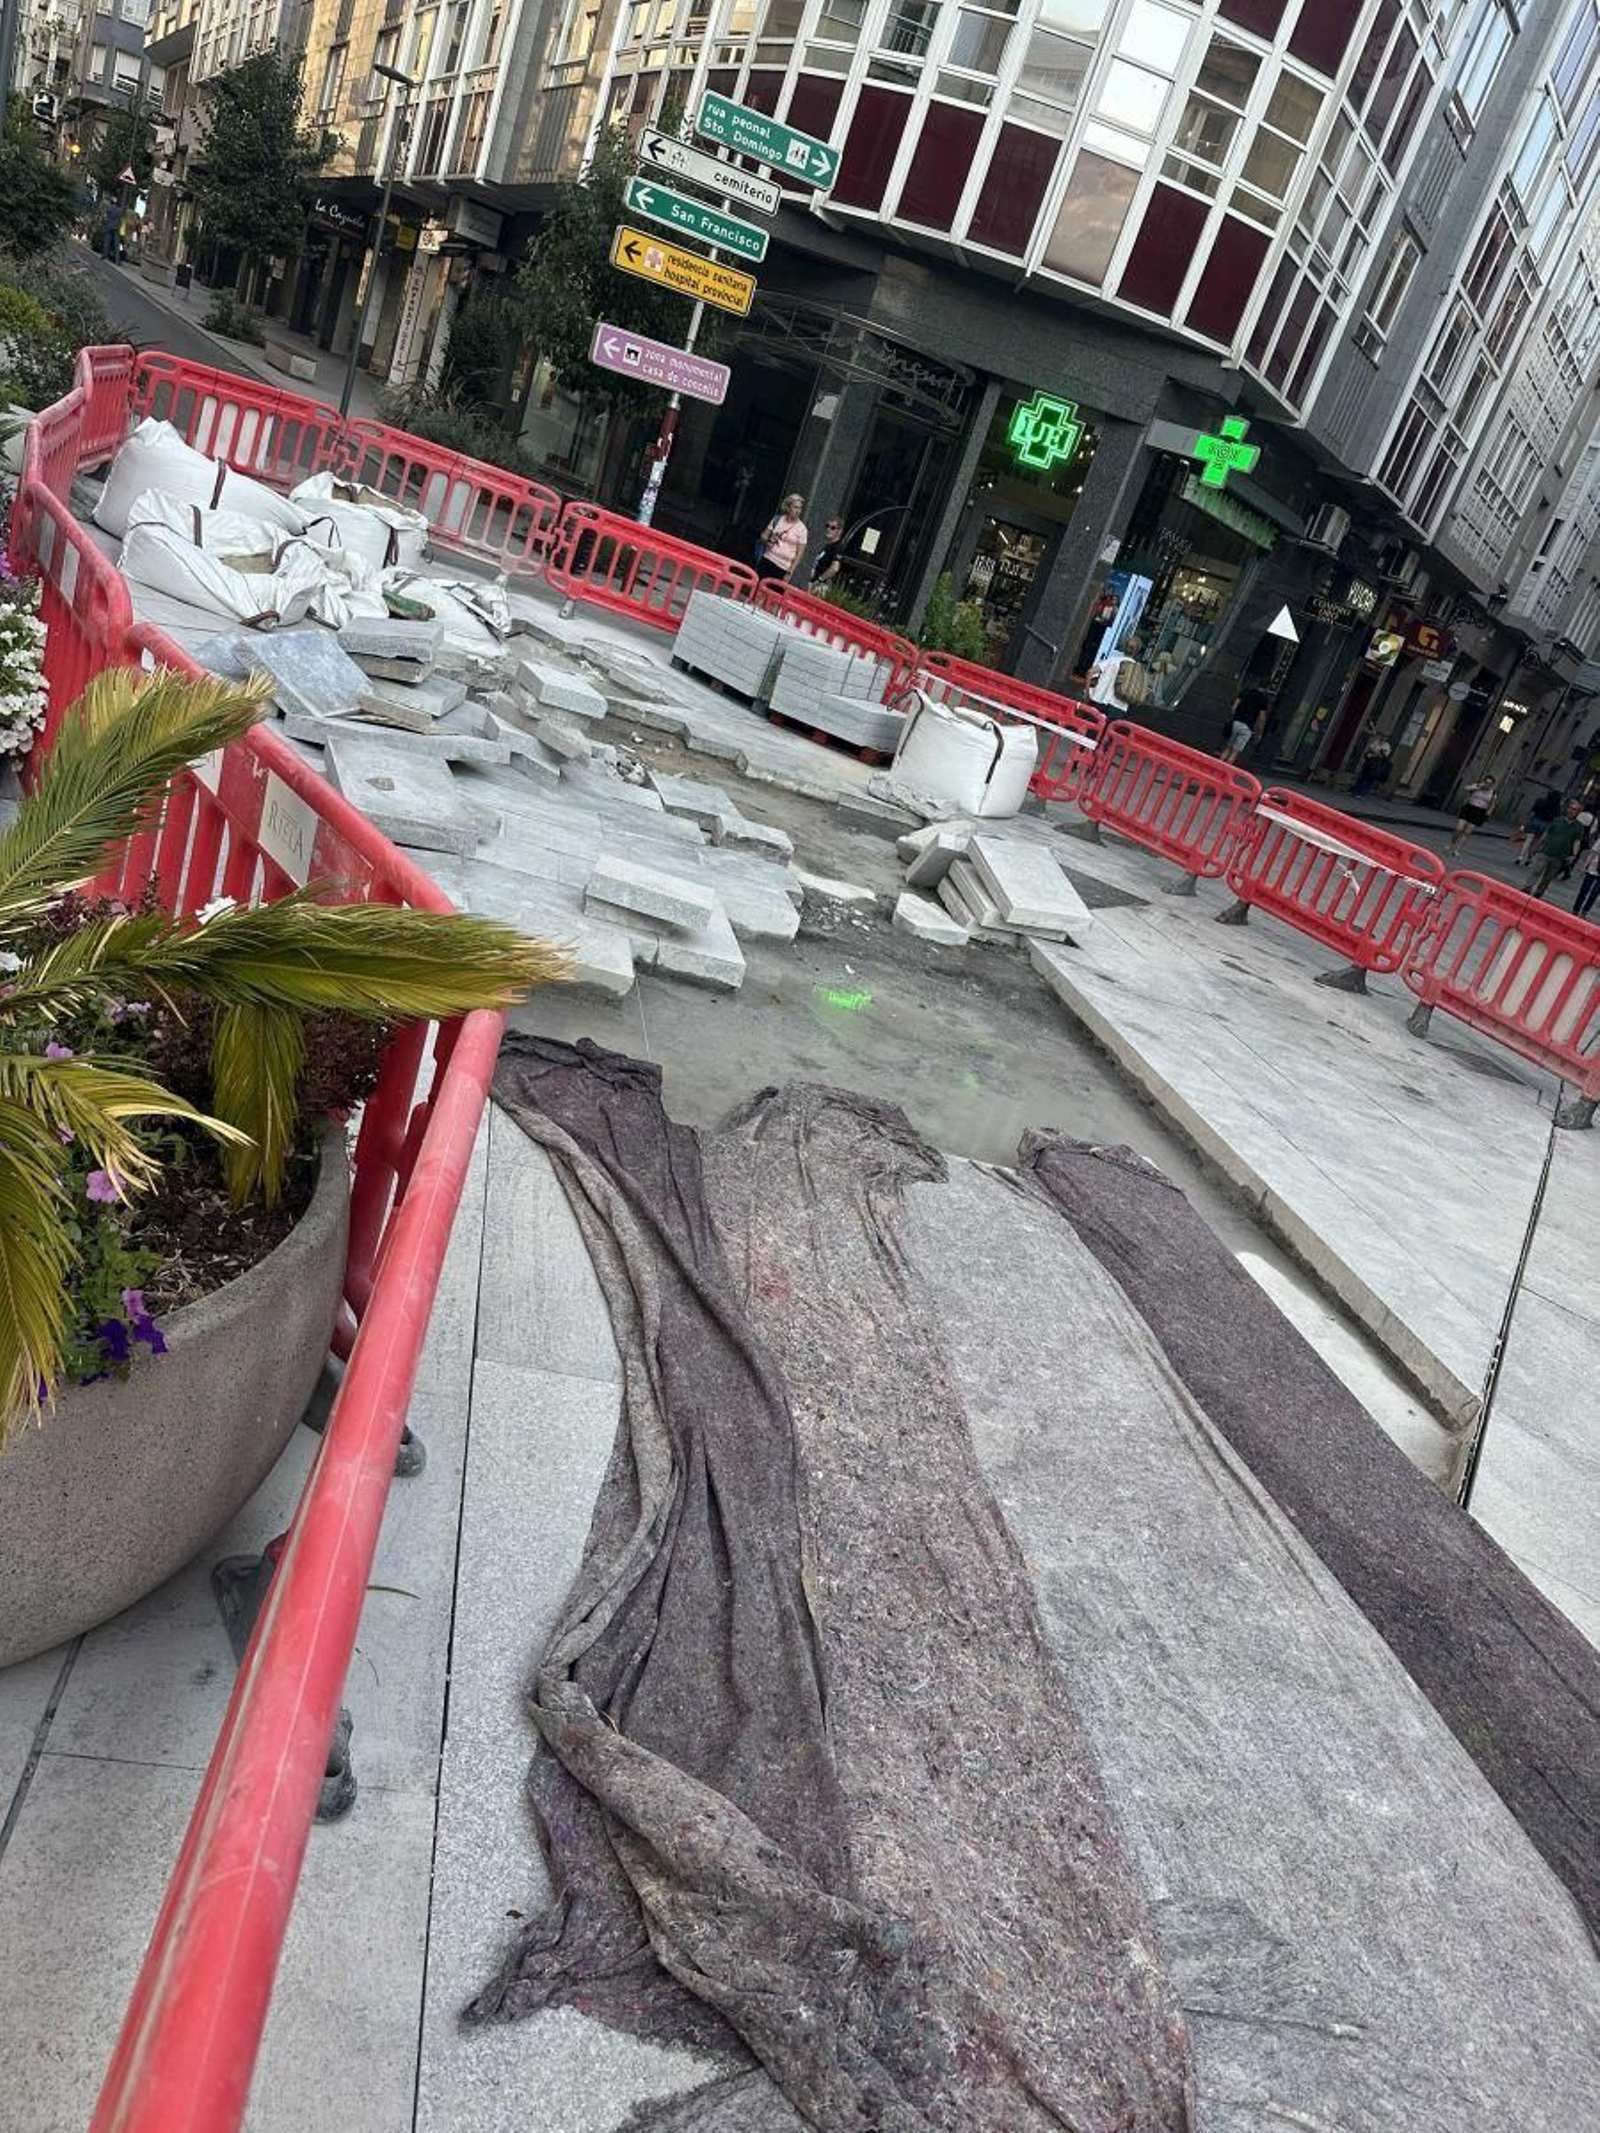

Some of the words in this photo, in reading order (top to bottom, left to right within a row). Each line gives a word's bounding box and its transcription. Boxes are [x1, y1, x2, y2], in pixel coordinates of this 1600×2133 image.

[704, 117, 728, 136] Sto.
[733, 131, 783, 160] Domingo
[731, 115, 771, 139] peonal
[714, 172, 772, 204] cemiterio
[671, 204, 695, 224] San
[701, 216, 760, 251] Francisco
[667, 255, 710, 278] residencia
[664, 267, 699, 290] hospital
[642, 364, 664, 378] casa
[667, 371, 680, 383] de
[669, 358, 723, 380] monumental
